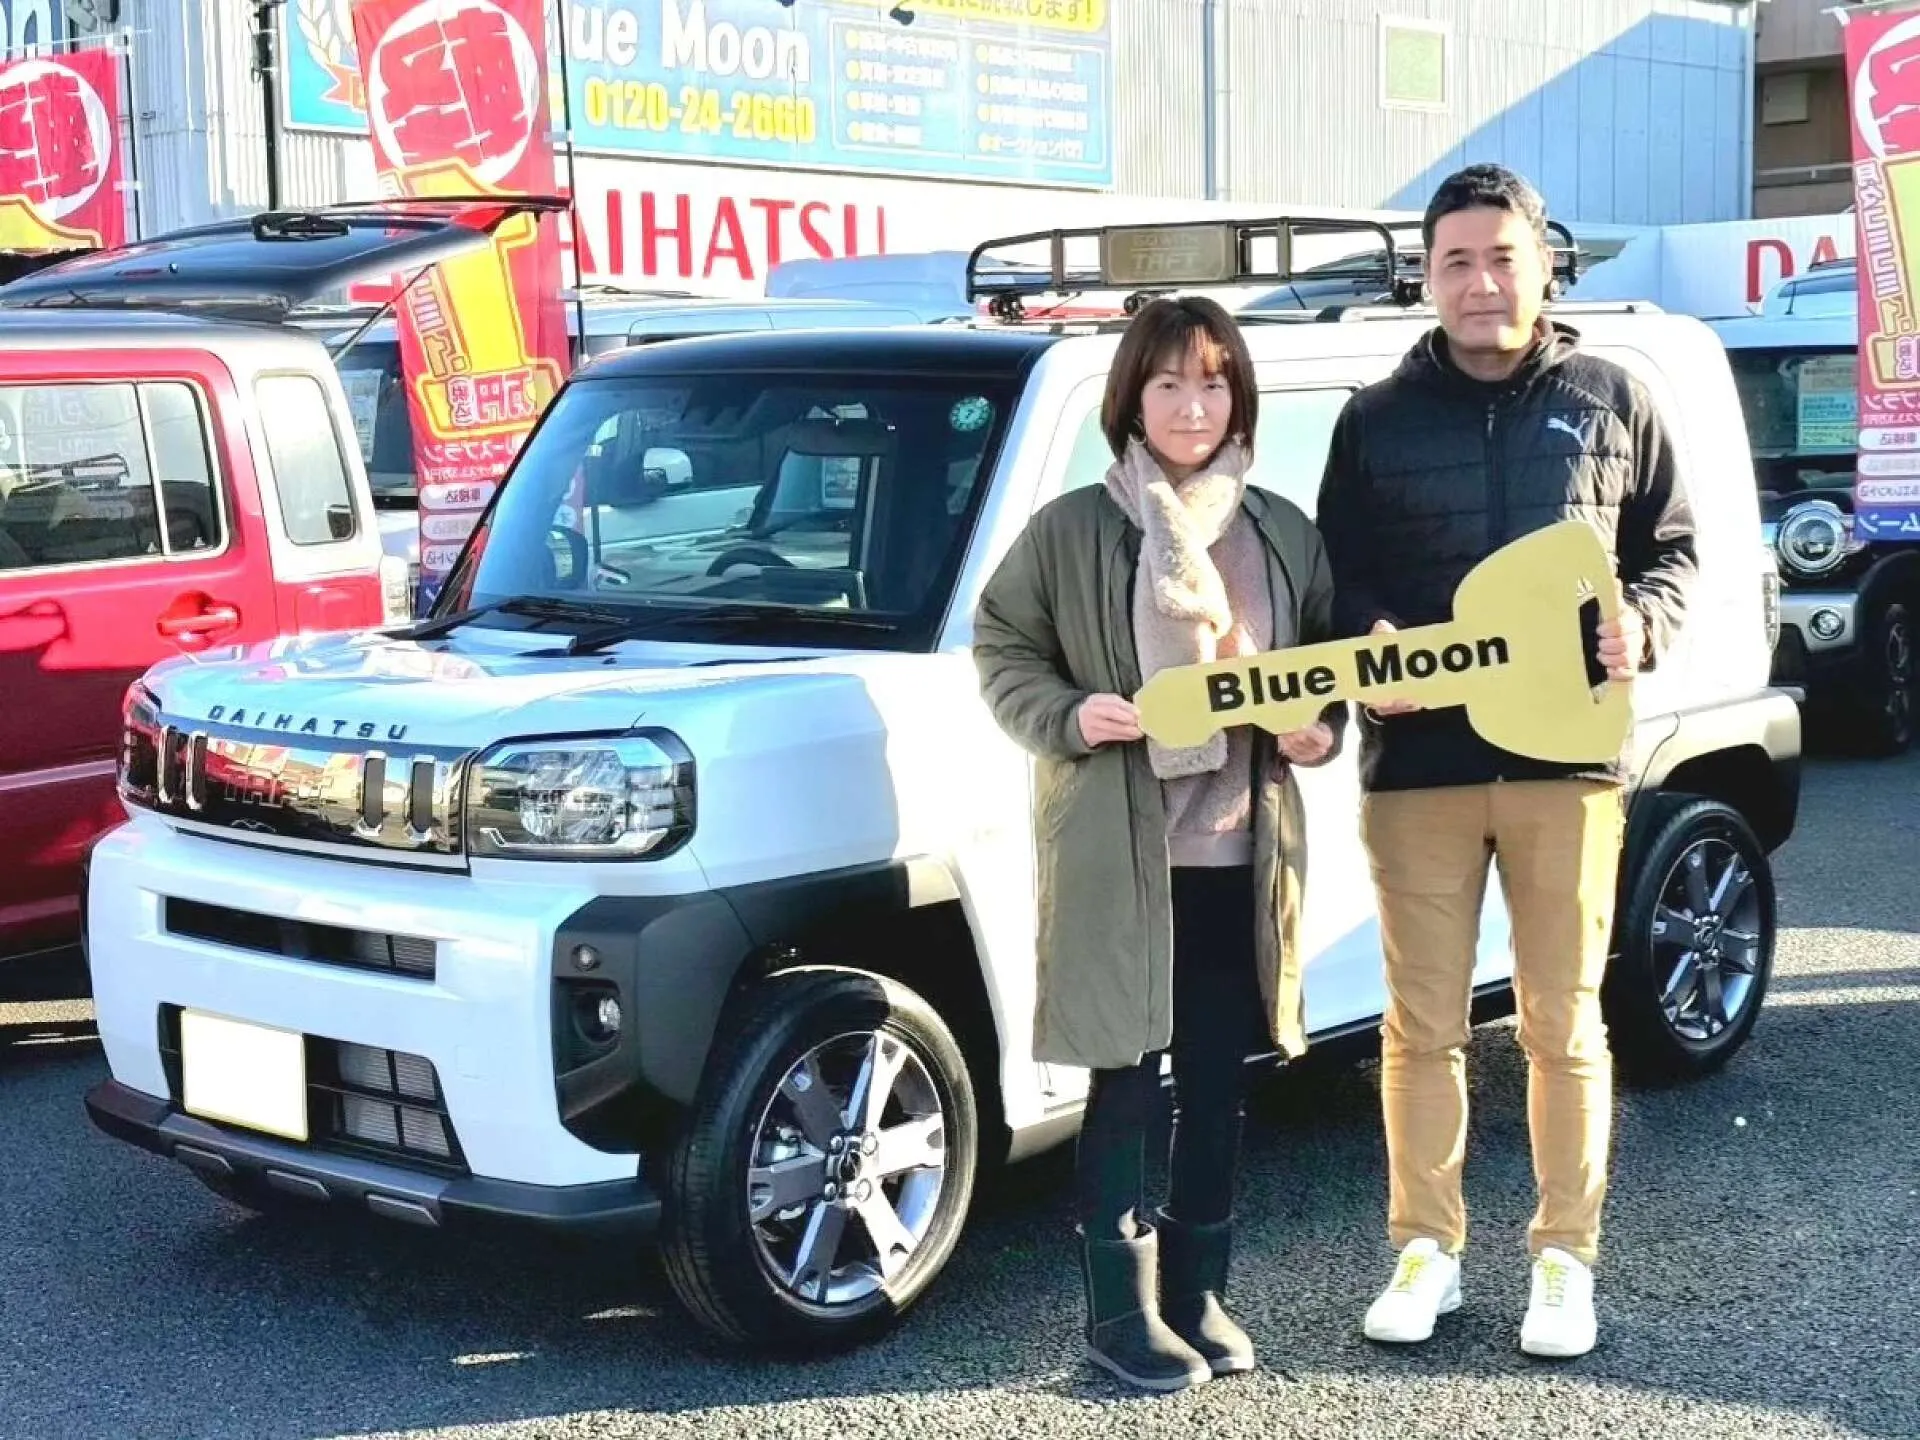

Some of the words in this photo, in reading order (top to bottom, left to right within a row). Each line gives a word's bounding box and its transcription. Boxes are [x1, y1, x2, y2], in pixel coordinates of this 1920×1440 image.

[661, 0, 811, 84] Moon
[584, 75, 816, 144] 0120-24-2660
[1206, 663, 1337, 713] Blue
[1355, 635, 1510, 688] Moon
[207, 704, 410, 740] DAIHATSU
